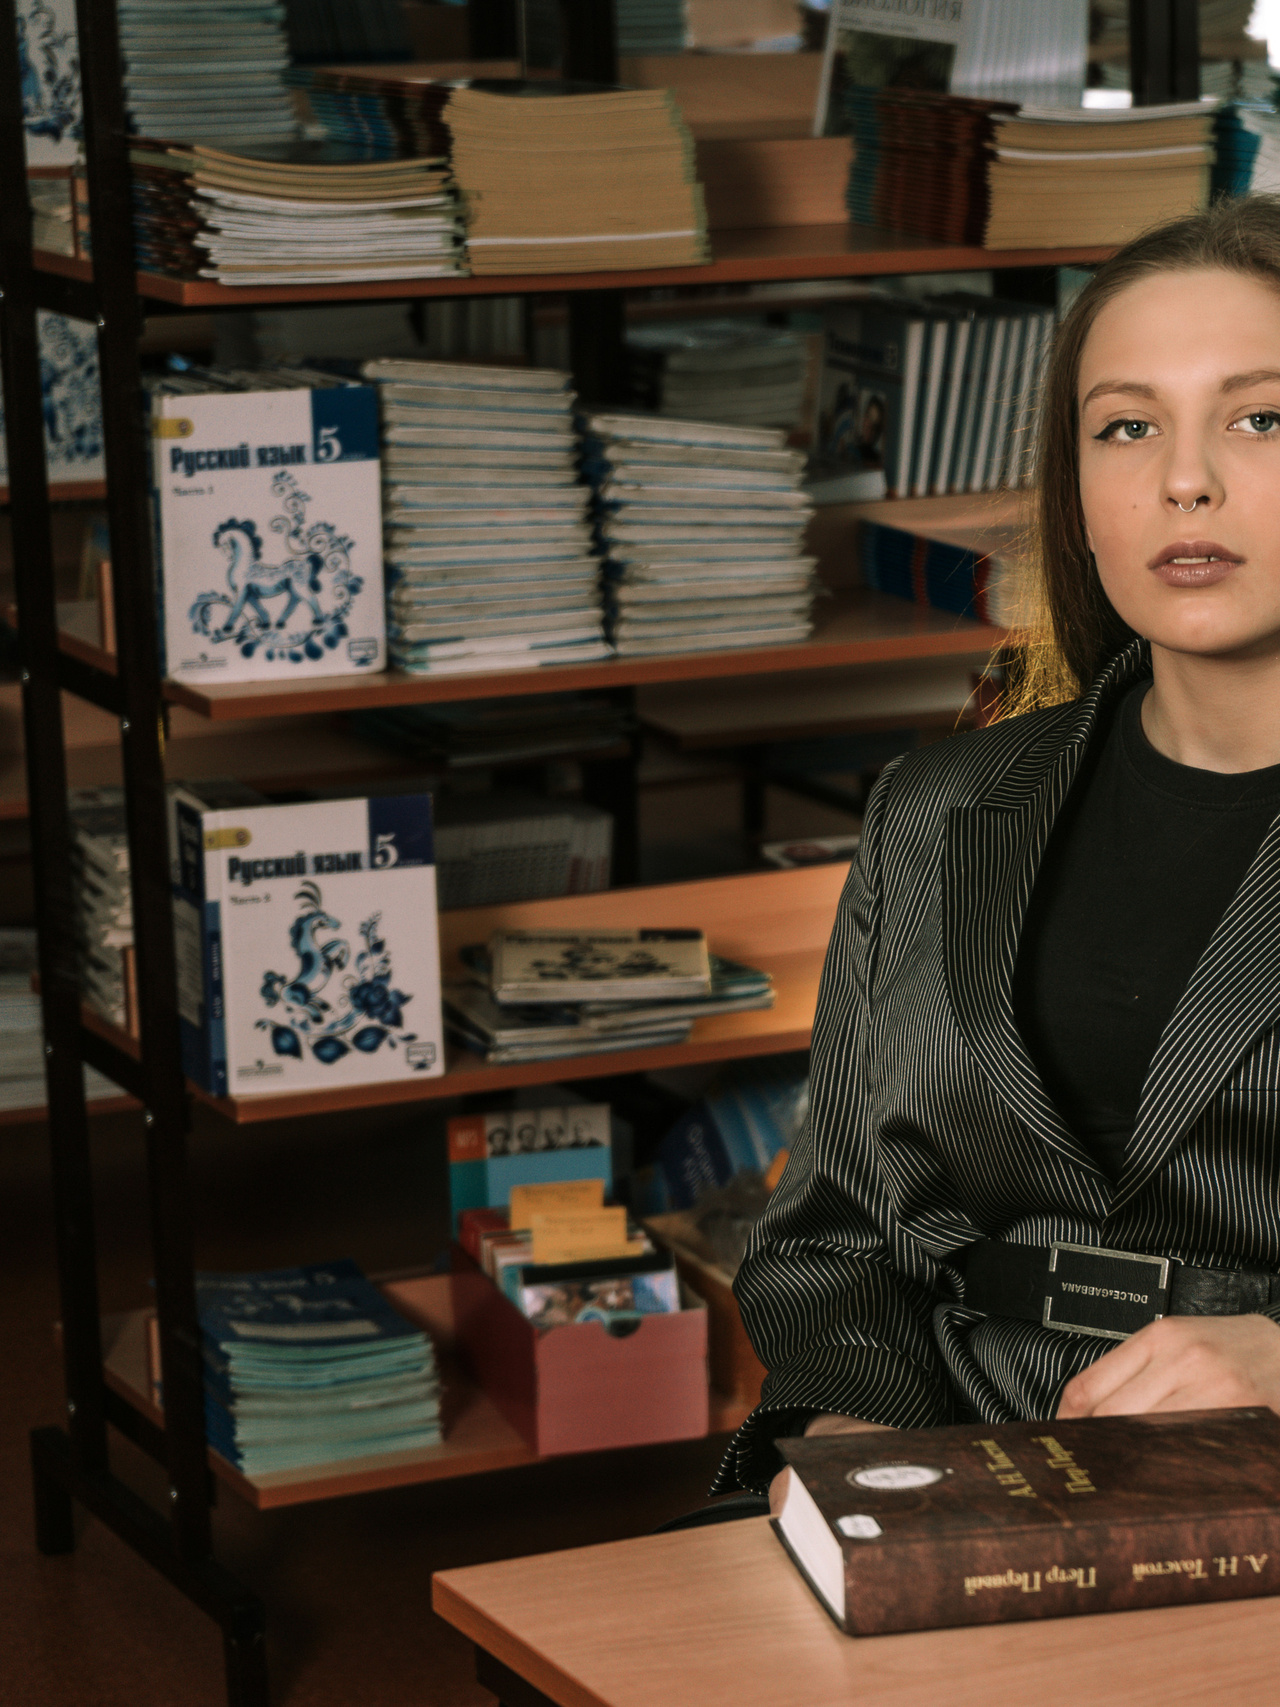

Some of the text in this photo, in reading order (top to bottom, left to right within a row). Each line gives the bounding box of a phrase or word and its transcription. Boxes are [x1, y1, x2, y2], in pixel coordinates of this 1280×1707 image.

[841, 0, 963, 23] ОЛОГИЯ
[170, 426, 343, 478] Русский язык 5
[228, 832, 400, 887] Русский язык 5
[1061, 1281, 1149, 1304] DOLCE&GABBANA
[1046, 1566, 1096, 1589] Петр
[1132, 1557, 1208, 1582] Толстой
[1212, 1555, 1239, 1576] Н.
[965, 1568, 1041, 1596] Первый
